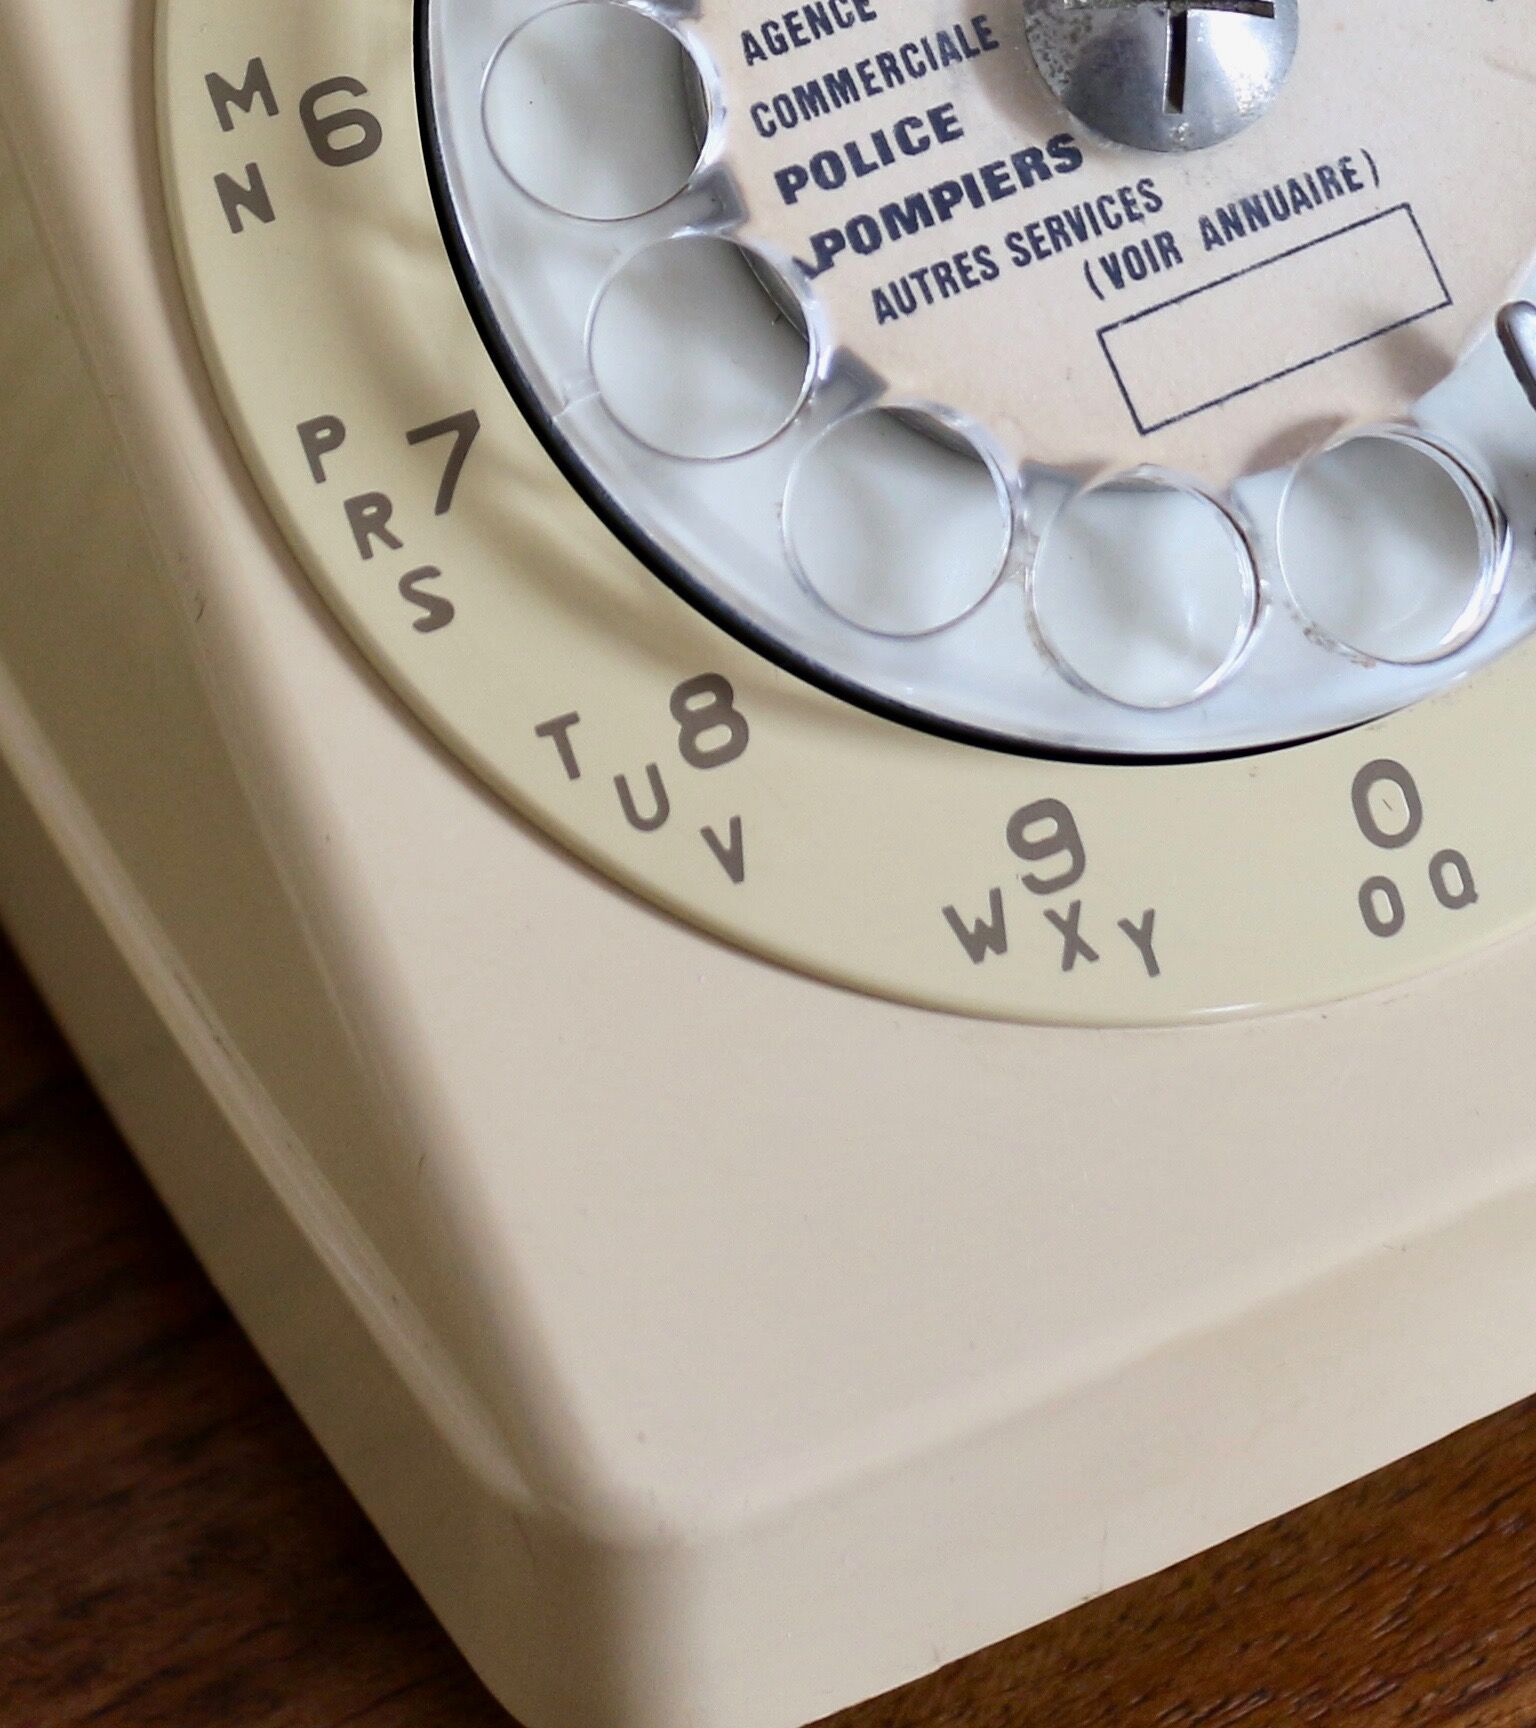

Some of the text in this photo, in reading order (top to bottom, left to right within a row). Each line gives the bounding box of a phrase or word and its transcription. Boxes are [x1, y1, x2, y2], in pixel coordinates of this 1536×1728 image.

[299, 76, 382, 167] 6
[750, 13, 1000, 139] COMMERCIALE
[774, 101, 964, 206] POLICE
[808, 133, 1084, 272] POMPIERS
[871, 178, 1164, 325] AUTRES SERVICES
[1083, 148, 1381, 301] (VOIR ANNUAIRE)
[406, 409, 481, 516] 7
[669, 672, 750, 769] 8
[1005, 797, 1086, 895] 9
